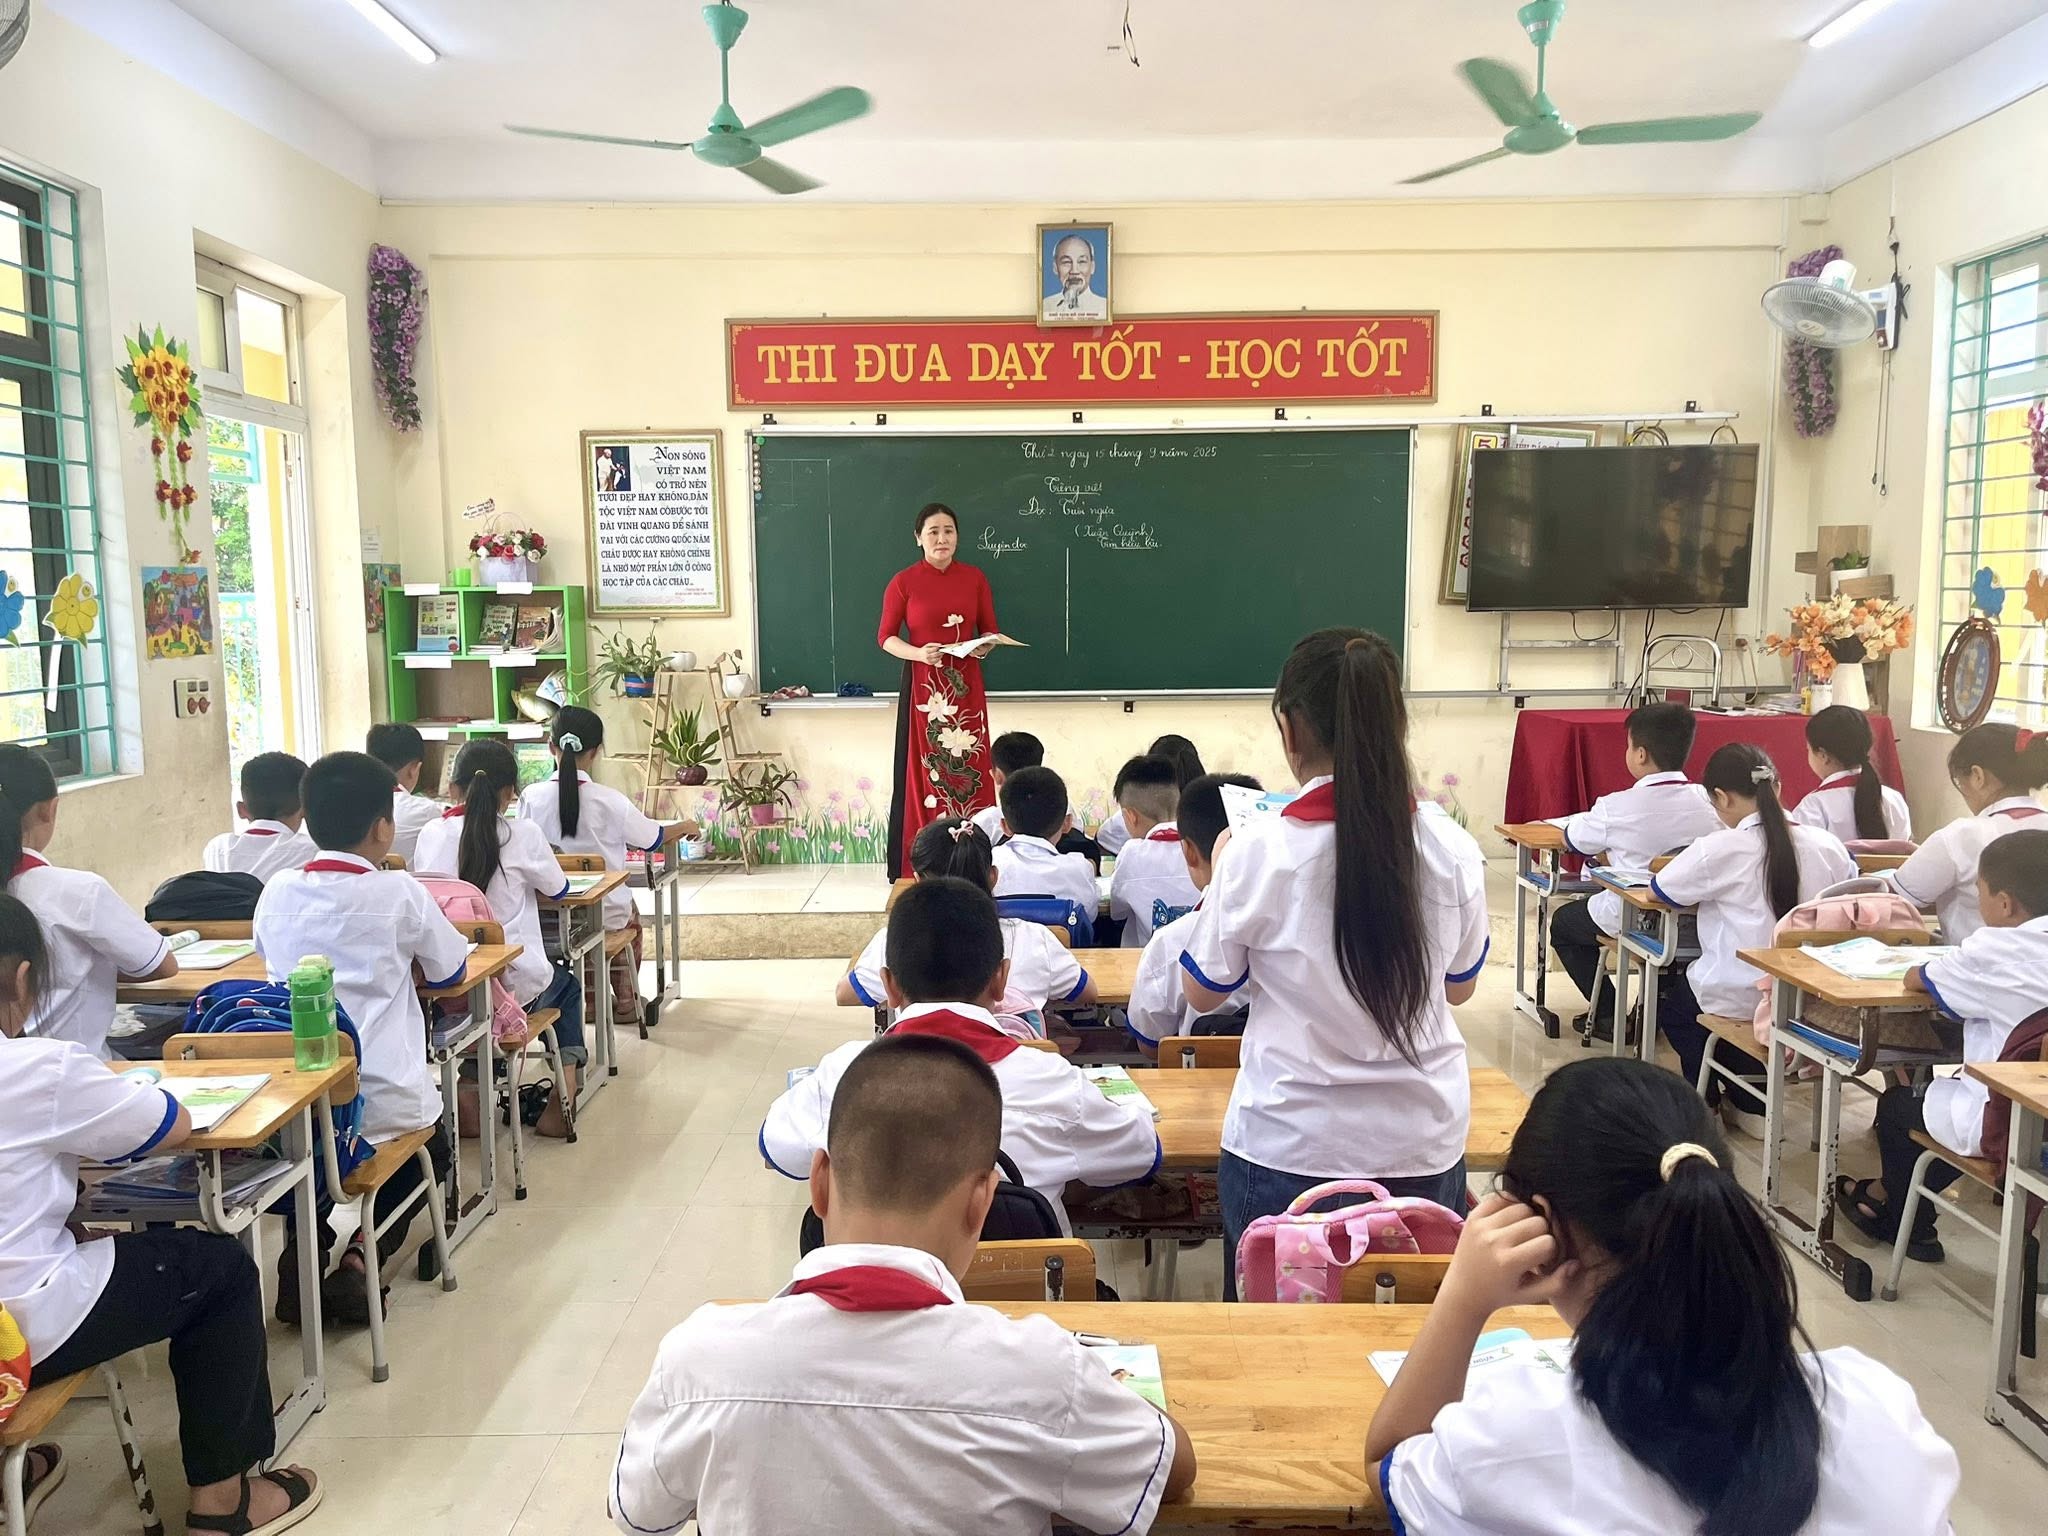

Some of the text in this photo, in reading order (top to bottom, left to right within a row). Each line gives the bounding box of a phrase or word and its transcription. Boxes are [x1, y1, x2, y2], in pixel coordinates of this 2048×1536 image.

[757, 322, 1408, 390] THI ĐUA DẠY TỐT - HỌC TỐT
[682, 450, 706, 460] SÔNG
[1095, 449, 1105, 458] 15
[1109, 442, 1142, 466] tháng
[1149, 447, 1157, 458] 9
[1193, 446, 1217, 458] 2025
[656, 465, 706, 476] VIỆT NAM
[655, 478, 707, 489] CÓ TRỞ NÊN
[598, 493, 617, 501] TƯƠI
[620, 494, 636, 503] ĐẸP
[638, 493, 656, 501] HAY
[599, 505, 615, 517] TỘC
[617, 505, 636, 517] VIỆT
[638, 507, 658, 515] NAM
[694, 506, 708, 515] TỚI
[600, 520, 614, 530] ĐÀI
[617, 522, 638, 530] VINH
[640, 521, 670, 530] QUANG
[686, 520, 709, 529] SÁNH
[600, 536, 613, 544] VAI
[615, 535, 628, 544] VỚI
[630, 534, 644, 544] CÁC
[671, 533, 692, 544] QUỐC
[601, 548, 620, 558] CHÂU
[643, 550, 658, 558] HAY
[660, 548, 686, 558] KHÔNG
[692, 561, 711, 571] CÔNG
[602, 578, 618, 588] HỌC
